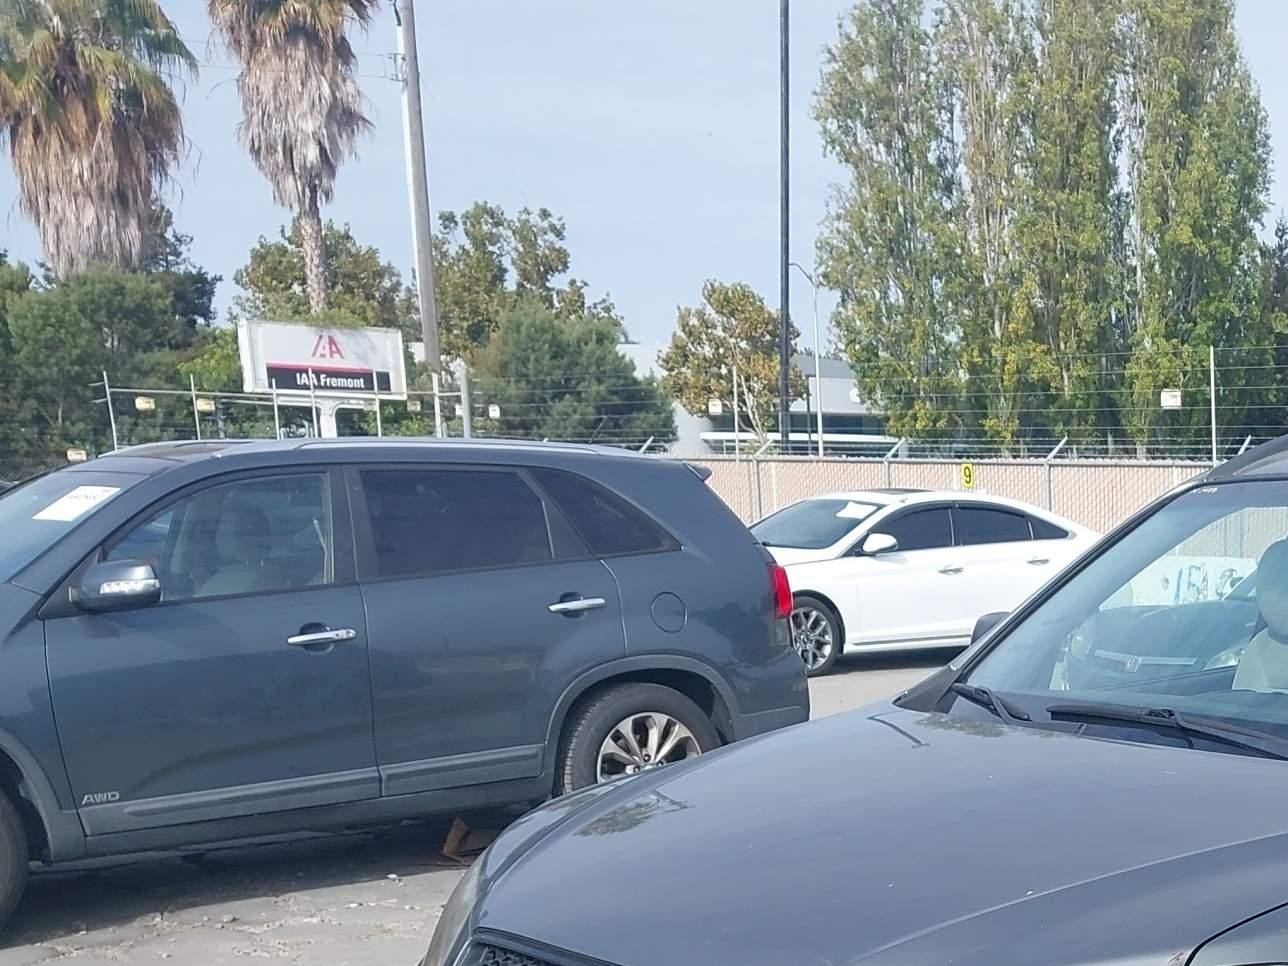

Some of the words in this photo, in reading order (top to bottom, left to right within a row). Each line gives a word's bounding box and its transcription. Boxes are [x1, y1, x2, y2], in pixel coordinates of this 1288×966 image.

[320, 374, 365, 388] Fremont
[963, 465, 972, 484] 9
[81, 791, 120, 806] AWD
